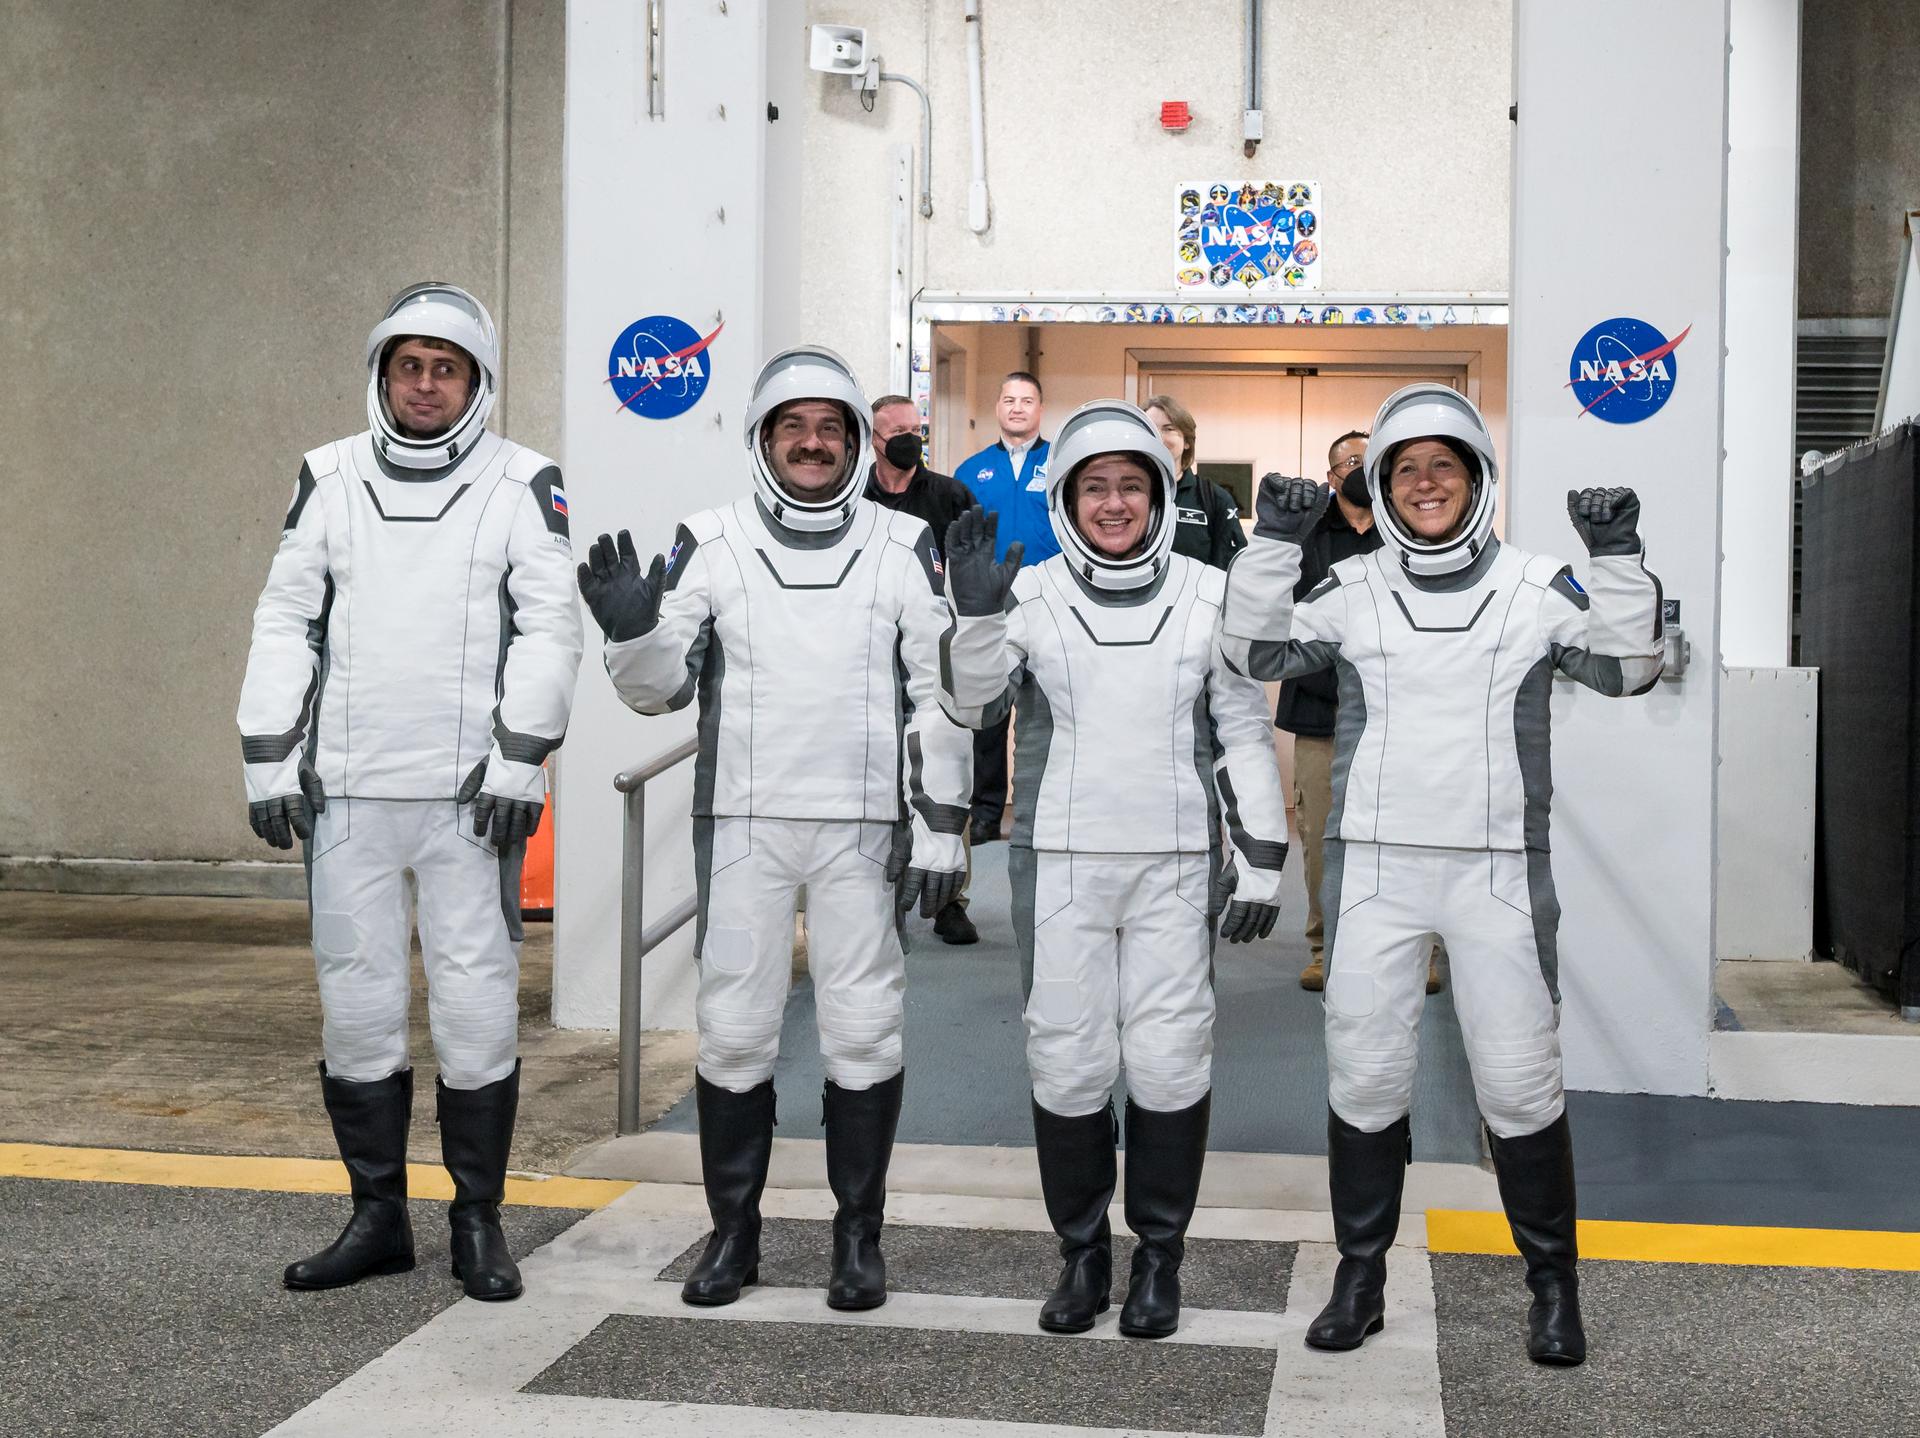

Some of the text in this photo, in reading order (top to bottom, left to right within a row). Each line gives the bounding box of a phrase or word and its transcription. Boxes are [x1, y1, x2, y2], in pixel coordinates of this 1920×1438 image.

[1208, 225, 1291, 247] NASA
[616, 356, 705, 378] NASA
[1579, 359, 1671, 382] NASA
